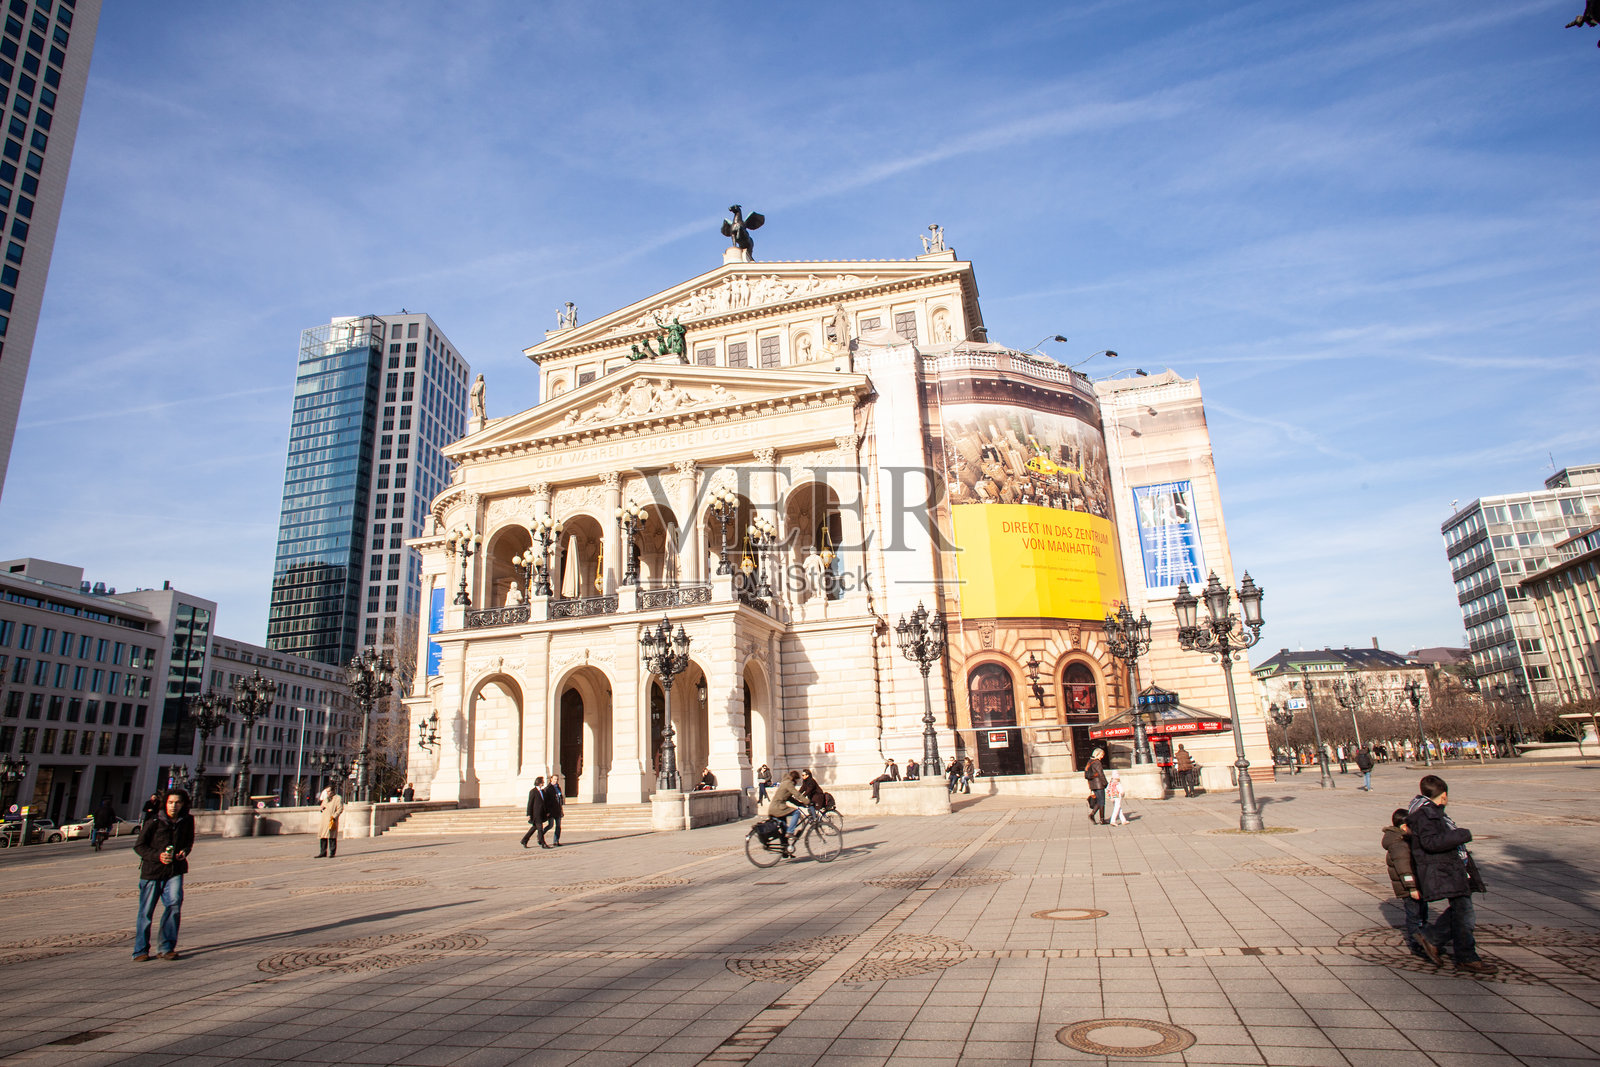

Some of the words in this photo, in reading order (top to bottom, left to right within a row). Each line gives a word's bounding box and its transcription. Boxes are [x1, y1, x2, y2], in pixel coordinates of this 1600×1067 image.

[537, 456, 563, 469] DEM
[569, 445, 624, 464] WAHREN
[632, 432, 704, 453] SCHOENEN
[1002, 521, 1039, 534] DIREKT
[1043, 524, 1052, 536] IN
[1055, 525, 1073, 539] DAS
[1075, 527, 1109, 545] ZENTRUM
[1022, 537, 1045, 550] VON
